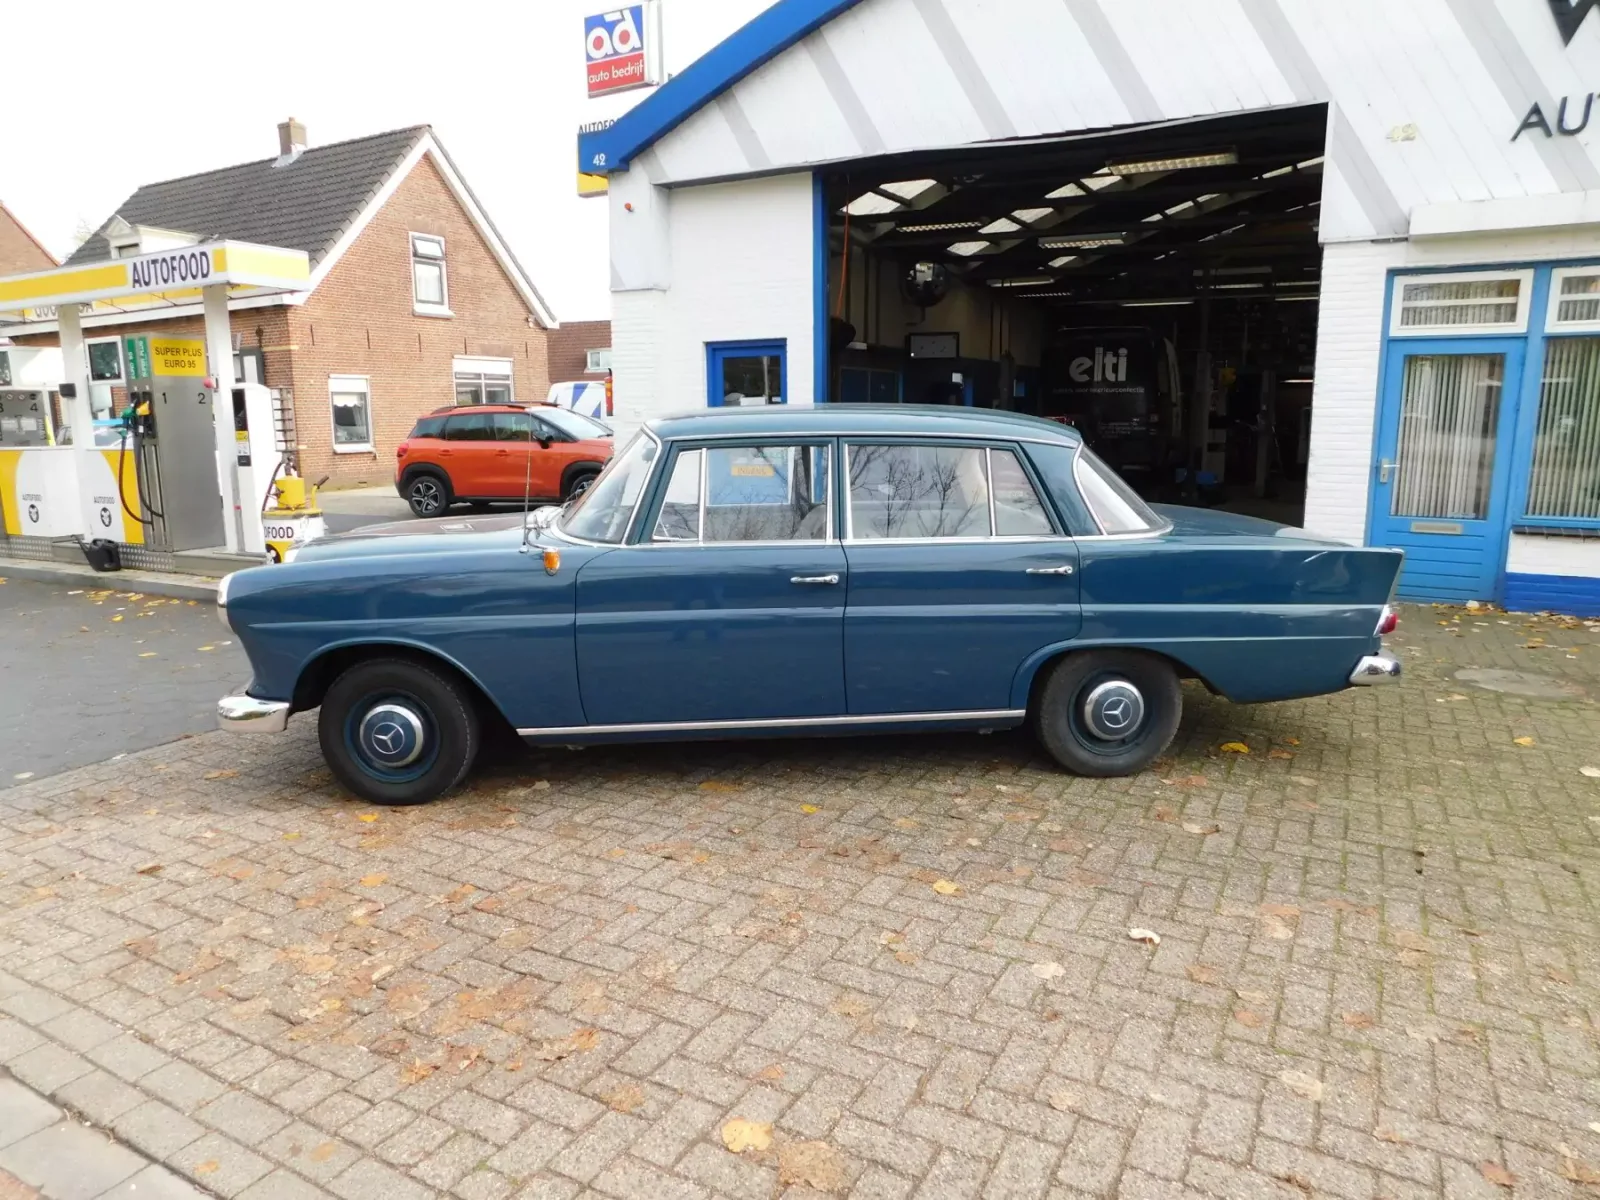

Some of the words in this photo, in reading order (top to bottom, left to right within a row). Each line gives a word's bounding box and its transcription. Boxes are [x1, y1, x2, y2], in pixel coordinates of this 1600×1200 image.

[587, 9, 641, 59] ad
[589, 73, 610, 84] auto
[612, 59, 643, 79] bedrijf
[1508, 92, 1600, 142] AU
[593, 153, 606, 166] 42
[132, 251, 211, 288] AUTOFOOD
[155, 347, 181, 356] SUPER
[183, 348, 203, 357] PLUS
[164, 360, 187, 368] EURO
[187, 360, 197, 369] 95
[1069, 347, 1128, 382] elti
[162, 392, 168, 404] 1
[198, 392, 207, 405] 2
[29, 402, 39, 412] 4
